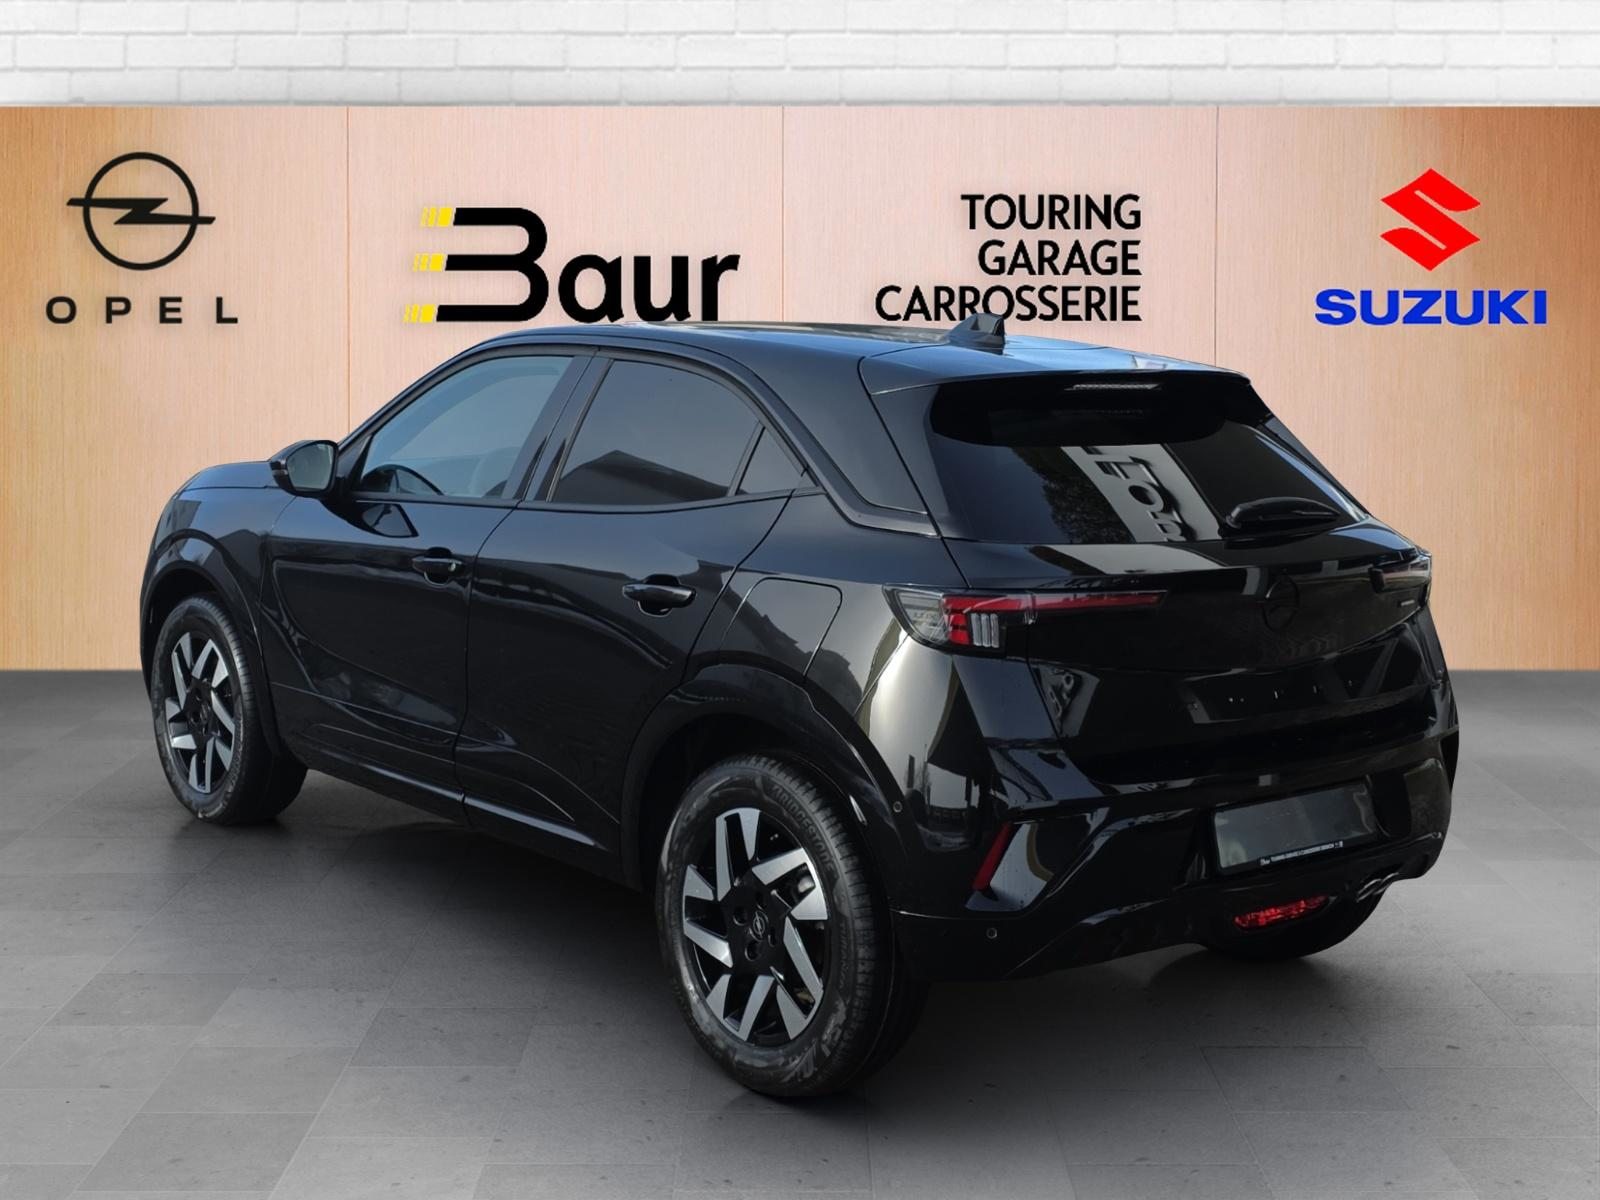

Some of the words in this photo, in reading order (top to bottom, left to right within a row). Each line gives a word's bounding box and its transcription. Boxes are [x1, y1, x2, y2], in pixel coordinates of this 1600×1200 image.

[960, 193, 1142, 231] TOURING
[434, 206, 741, 324] Baur
[977, 239, 1143, 277] GARAGE
[45, 295, 239, 325] OPEL
[874, 284, 1143, 322] CARROSSERIE
[1314, 288, 1548, 326] SUZUKI
